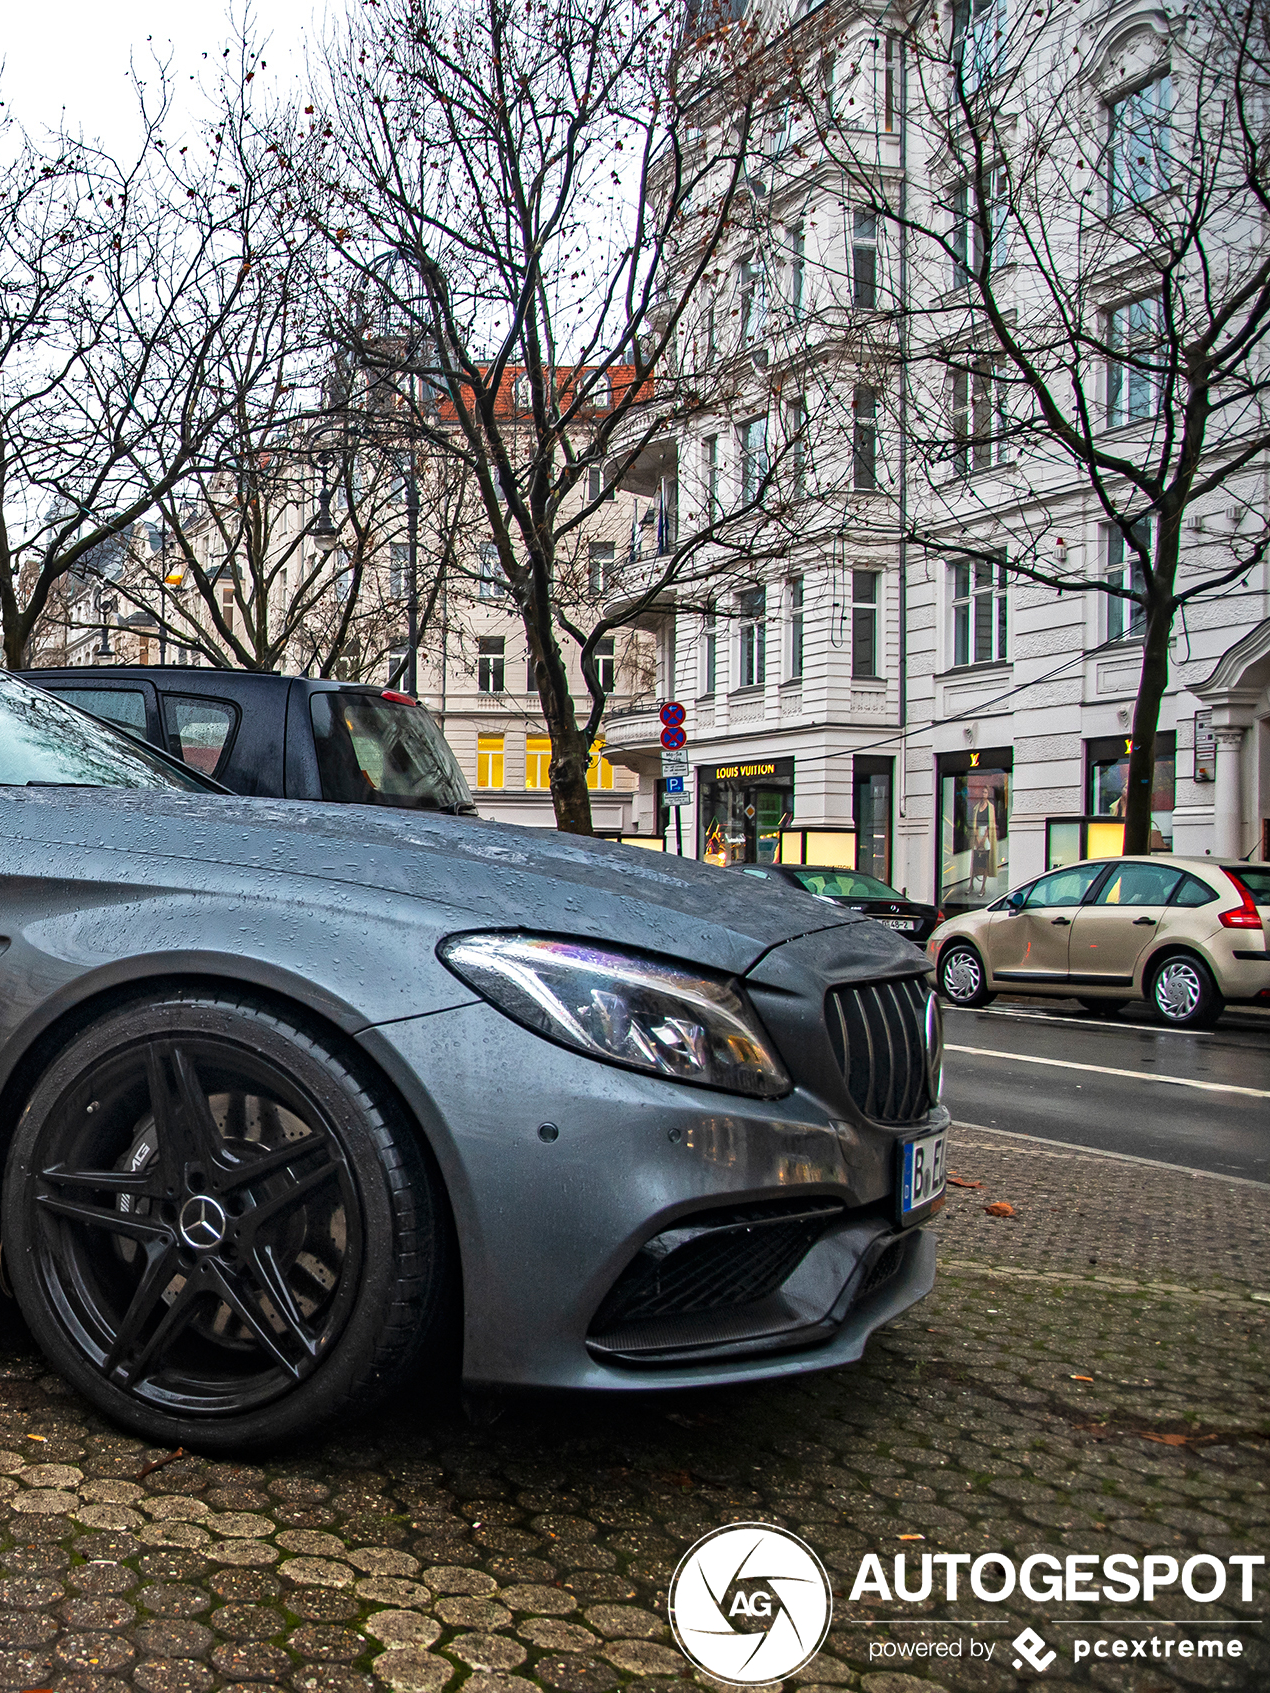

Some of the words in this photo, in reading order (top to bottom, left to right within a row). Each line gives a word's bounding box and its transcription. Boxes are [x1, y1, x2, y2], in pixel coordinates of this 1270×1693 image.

[716, 766, 739, 780] LOUIS
[740, 764, 775, 777] VUITTON
[670, 779, 679, 791] P
[130, 1142, 150, 1172] MG
[913, 1146, 924, 1200] B
[932, 1139, 944, 1190] E
